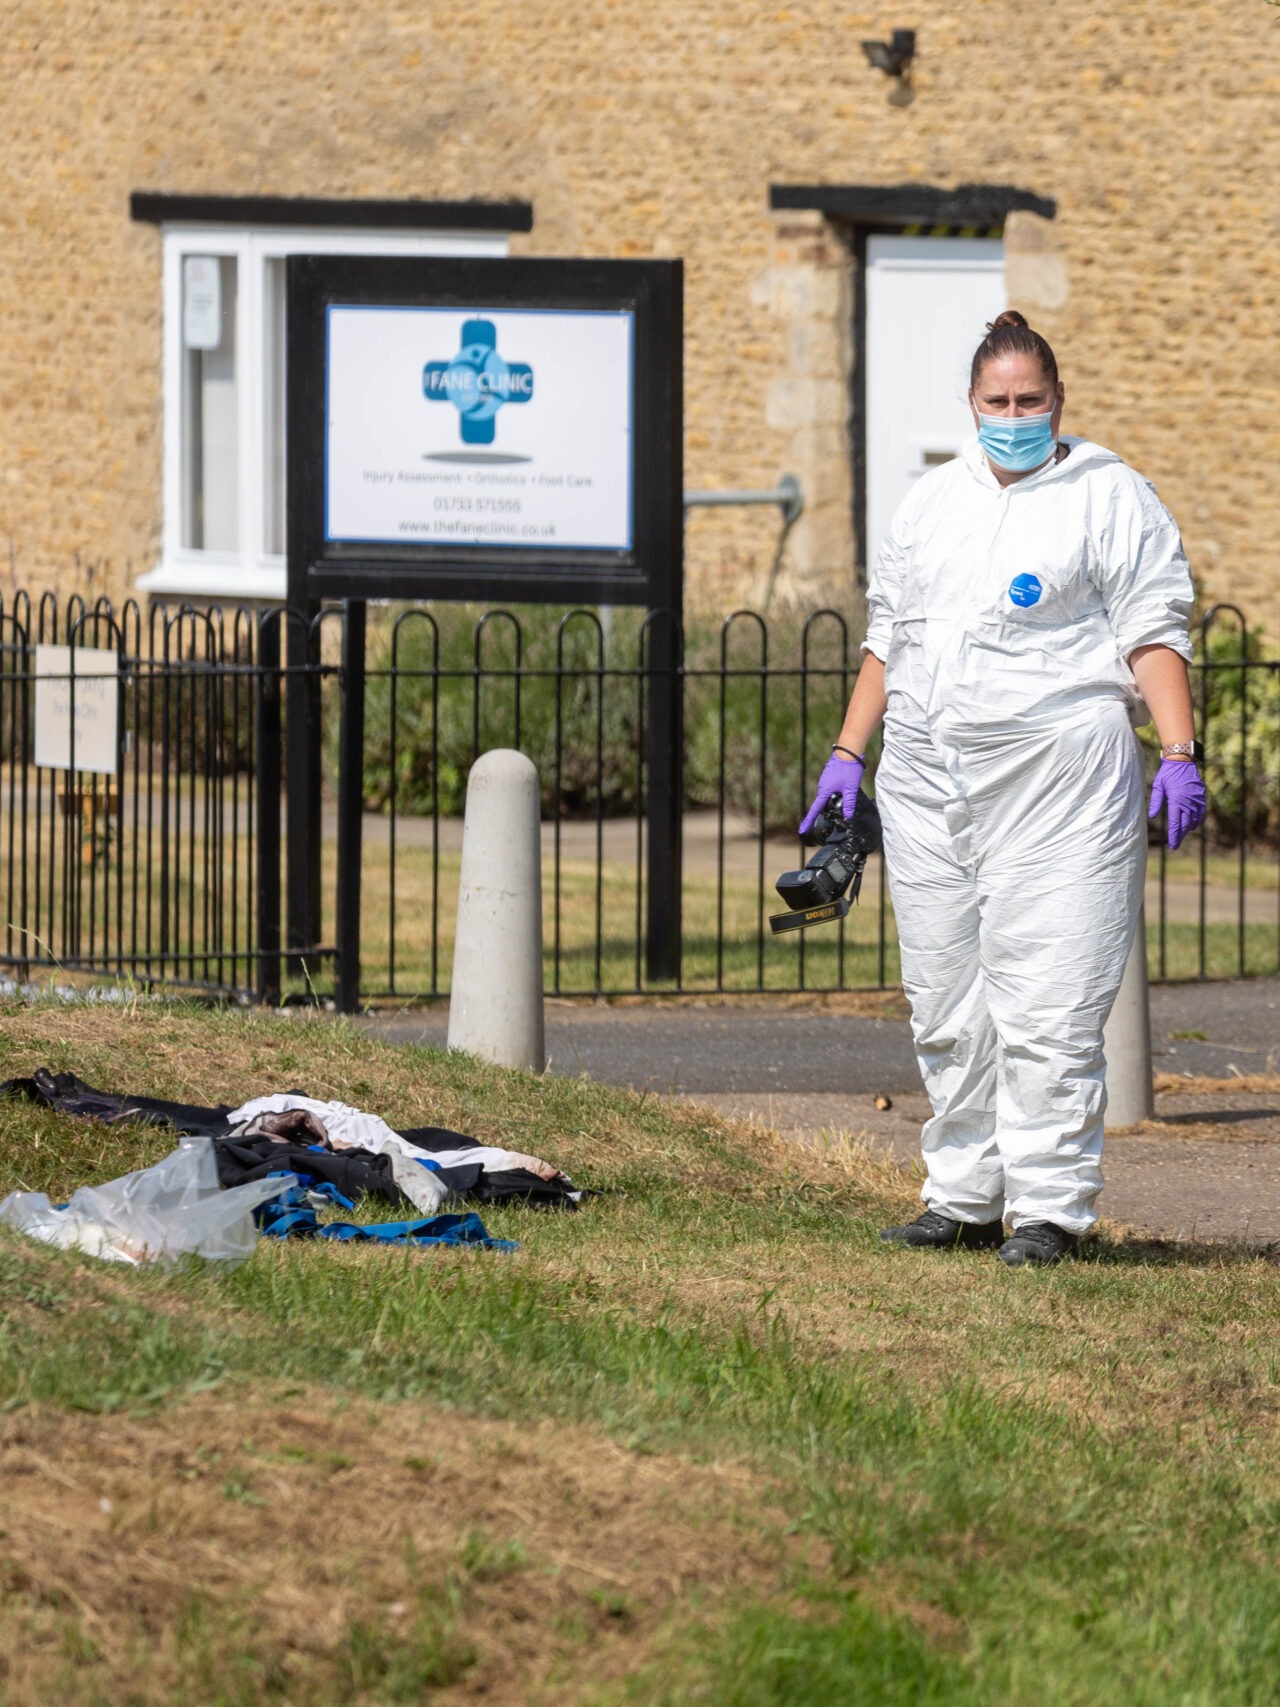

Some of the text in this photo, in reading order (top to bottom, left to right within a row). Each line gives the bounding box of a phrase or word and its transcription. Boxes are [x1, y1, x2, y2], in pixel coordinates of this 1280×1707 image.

[430, 370, 474, 392] FANE
[477, 371, 533, 394] CLINIC
[362, 470, 592, 488] Injury Assessment Orthotics Foot Care
[433, 496, 472, 512] 01733
[398, 519, 556, 536] www.thefaneclinic.co.uk
[805, 907, 835, 920] Nikon
